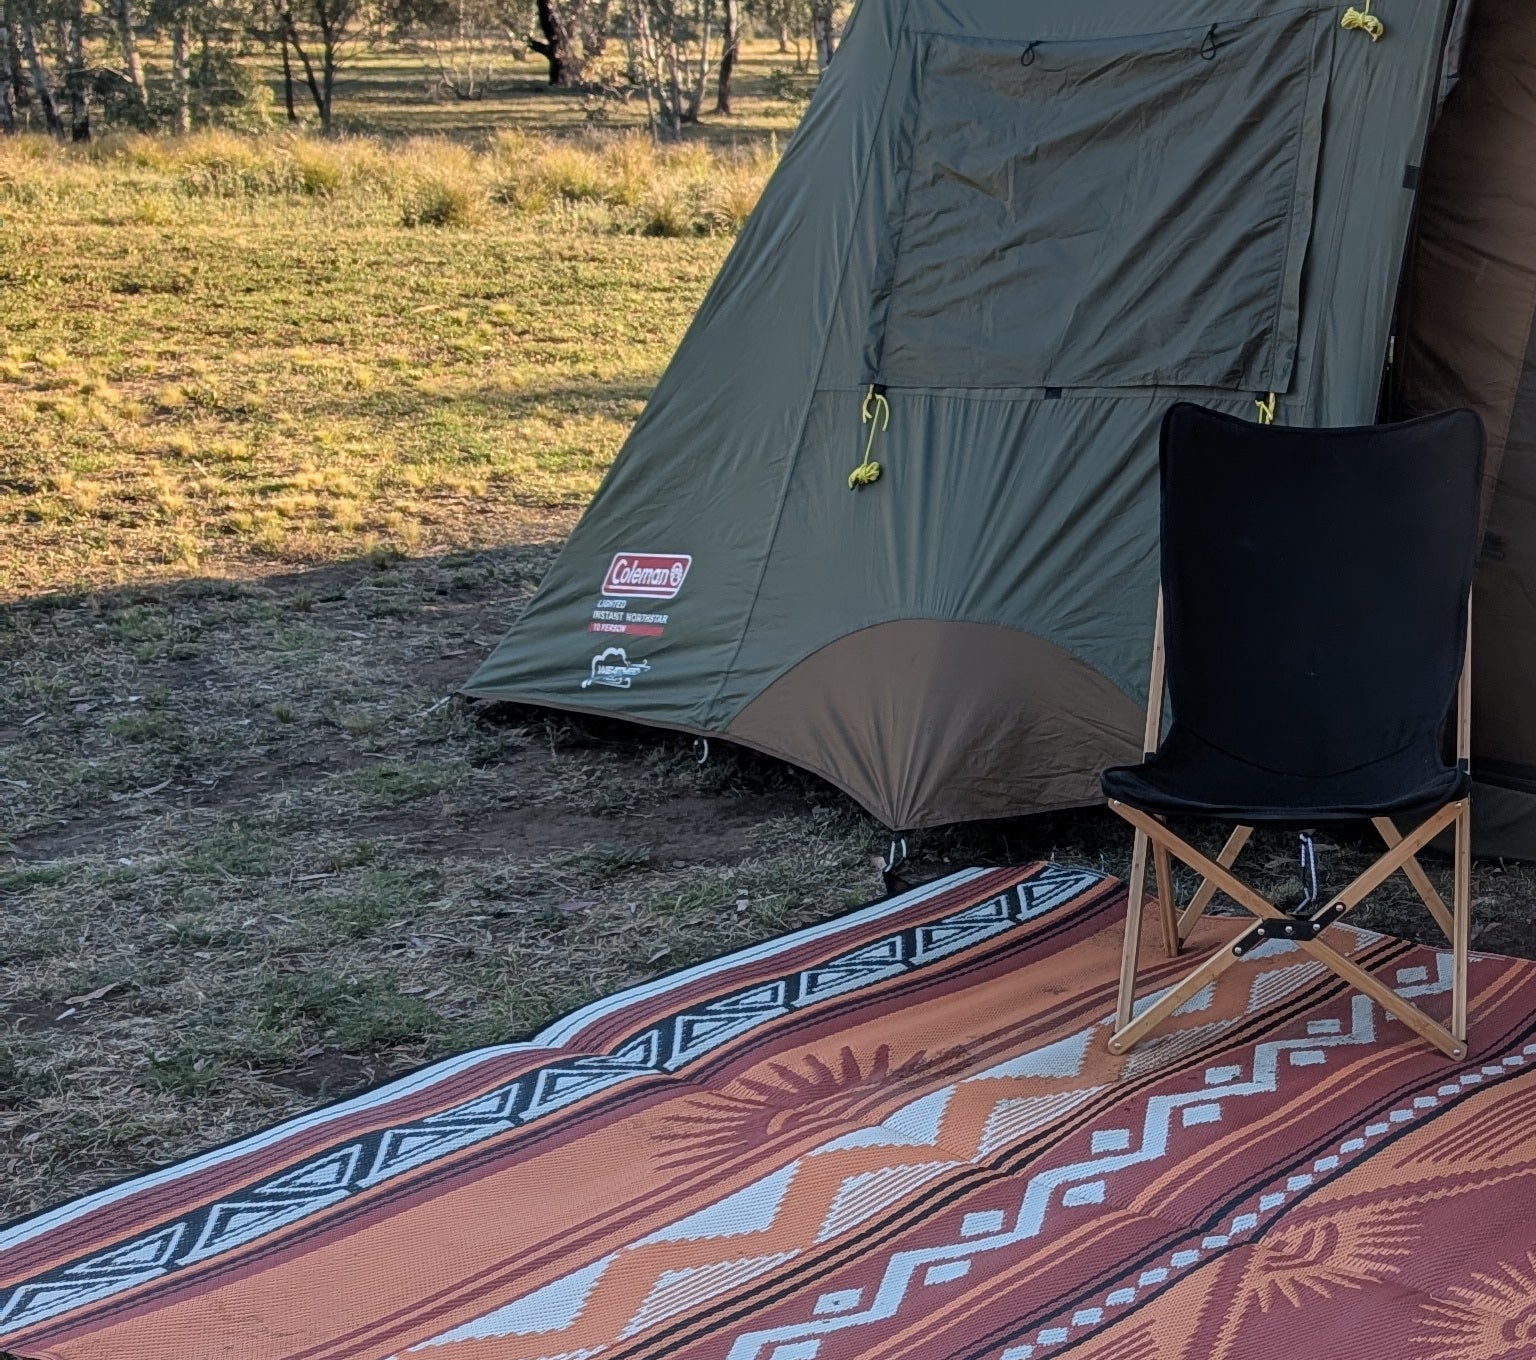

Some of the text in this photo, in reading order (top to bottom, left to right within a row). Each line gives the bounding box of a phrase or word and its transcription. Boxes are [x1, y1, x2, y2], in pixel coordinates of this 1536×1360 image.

[612, 558, 669, 586] Coleman
[597, 599, 627, 609] LIGHTED
[593, 610, 669, 624] INSTANT NORTHSTAR
[600, 623, 627, 633] PERSON
